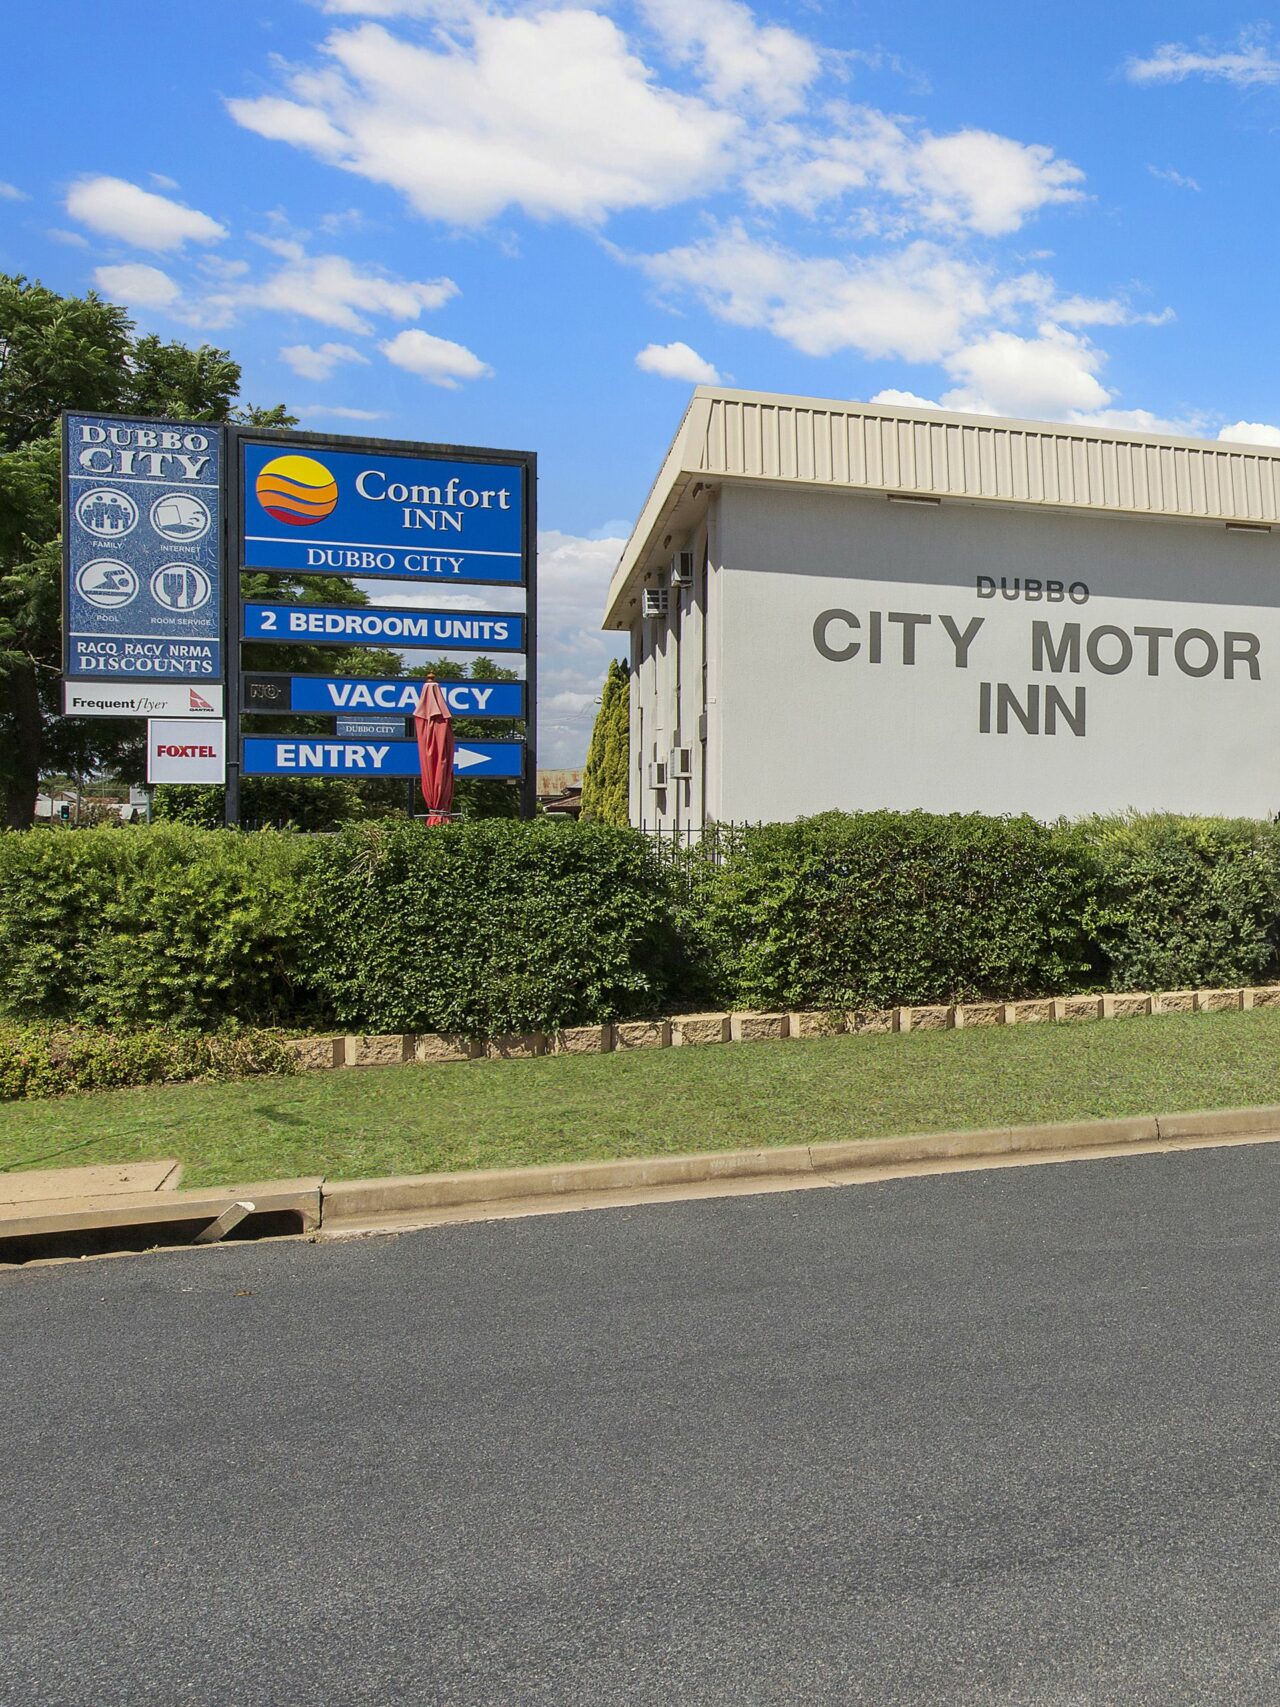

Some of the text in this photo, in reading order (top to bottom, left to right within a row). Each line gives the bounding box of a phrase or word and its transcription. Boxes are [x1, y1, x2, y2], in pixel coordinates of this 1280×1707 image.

[80, 425, 209, 451] DUBBO
[79, 447, 210, 480] CITY
[355, 470, 511, 510] Comfort
[402, 508, 464, 532] INN
[92, 540, 123, 549] FAMILY
[160, 545, 201, 553] INTERNET
[307, 548, 465, 573] DUBBO CITY
[976, 575, 1090, 605] DUBBO
[150, 617, 211, 626] ROOM SERVICE
[260, 611, 509, 640] 2 BEDROOM UNITS
[77, 642, 212, 657] RACQ RACV NRMA
[812, 608, 1261, 681] CITY MOTOR
[79, 656, 213, 673] DISCOUNTS
[72, 698, 168, 712] Frequent flyer
[327, 683, 494, 710] VACACY
[979, 682, 1086, 736] INN
[345, 725, 374, 733] DUBBO
[157, 745, 216, 758] FOXTEL
[276, 745, 390, 768] ENTRY
